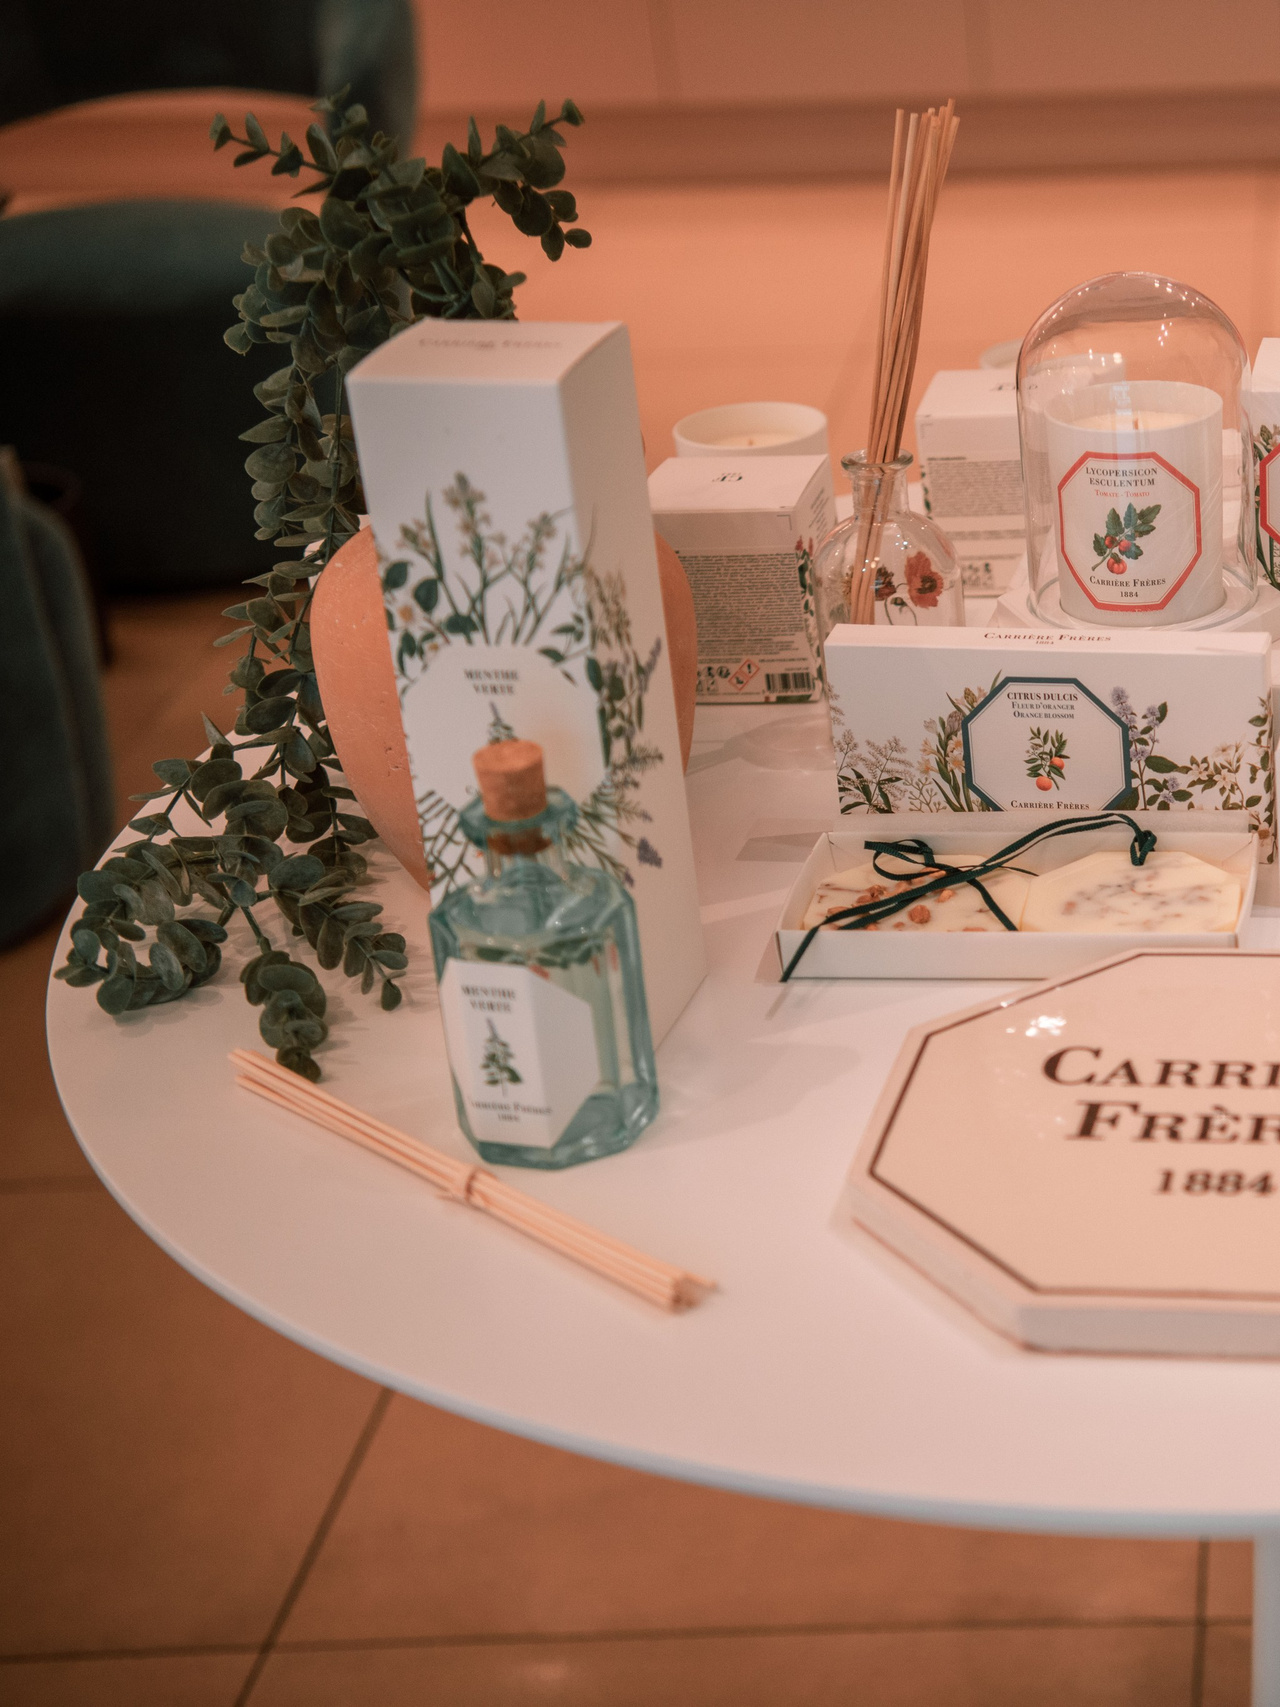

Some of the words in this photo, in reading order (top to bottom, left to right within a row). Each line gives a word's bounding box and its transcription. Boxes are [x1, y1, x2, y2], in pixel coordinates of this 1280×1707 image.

[1086, 466, 1158, 477] LYCOPERSICON
[1089, 478, 1156, 487] ESCULENTUM
[1089, 575, 1130, 588] CARRIÈRE
[1132, 577, 1166, 588] FRÈRES
[984, 632, 1054, 640] CARRIÈRE
[1058, 633, 1112, 642] FRÈRES
[1007, 692, 1041, 700] CITRUS
[1043, 693, 1078, 701] DULCIS
[1012, 702, 1034, 710] FLEUR
[1014, 710, 1043, 718] ORANGE
[1010, 799, 1054, 810] CARRIÈRE
[1056, 801, 1090, 810] FRÈRES
[1153, 1167, 1278, 1197] 1884
